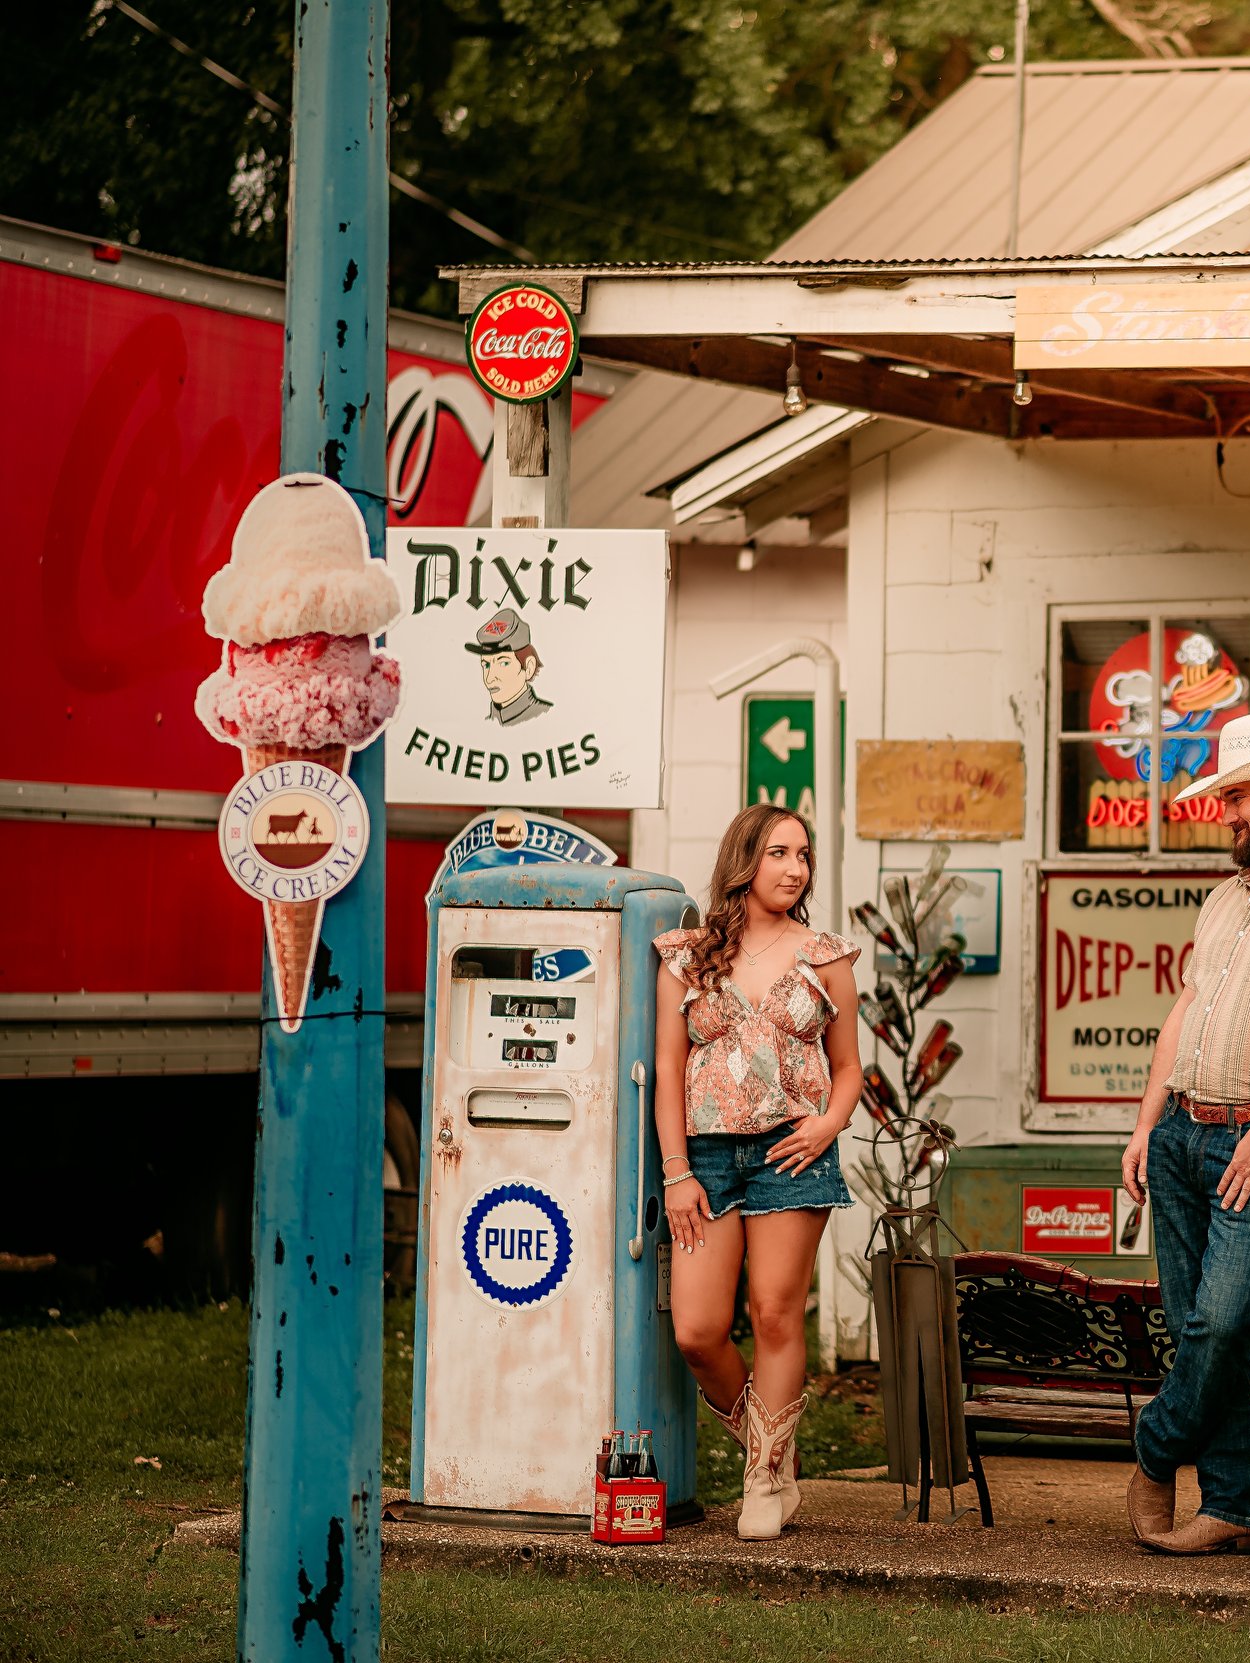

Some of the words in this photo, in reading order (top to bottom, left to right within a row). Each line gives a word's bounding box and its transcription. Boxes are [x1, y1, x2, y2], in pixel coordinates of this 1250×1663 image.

[487, 296, 515, 322] ICE
[516, 293, 558, 320] COLD
[475, 326, 569, 361] Coca-Cola
[486, 367, 521, 394] SOLD
[524, 364, 560, 393] HERE
[407, 537, 595, 615] Dixie
[404, 726, 510, 783] FRIED
[521, 732, 602, 782] PIES
[233, 765, 293, 816] BLUE
[300, 765, 355, 813] BELL
[1087, 796, 1146, 829] DOG
[451, 822, 492, 872] BLUE
[230, 846, 269, 891] ICE
[272, 846, 358, 900] CREAM
[1073, 1026, 1160, 1047] MOTOR
[1070, 1062, 1152, 1077] BOWMA
[1051, 1204, 1110, 1233] Pepper
[485, 1227, 549, 1261] PURE
